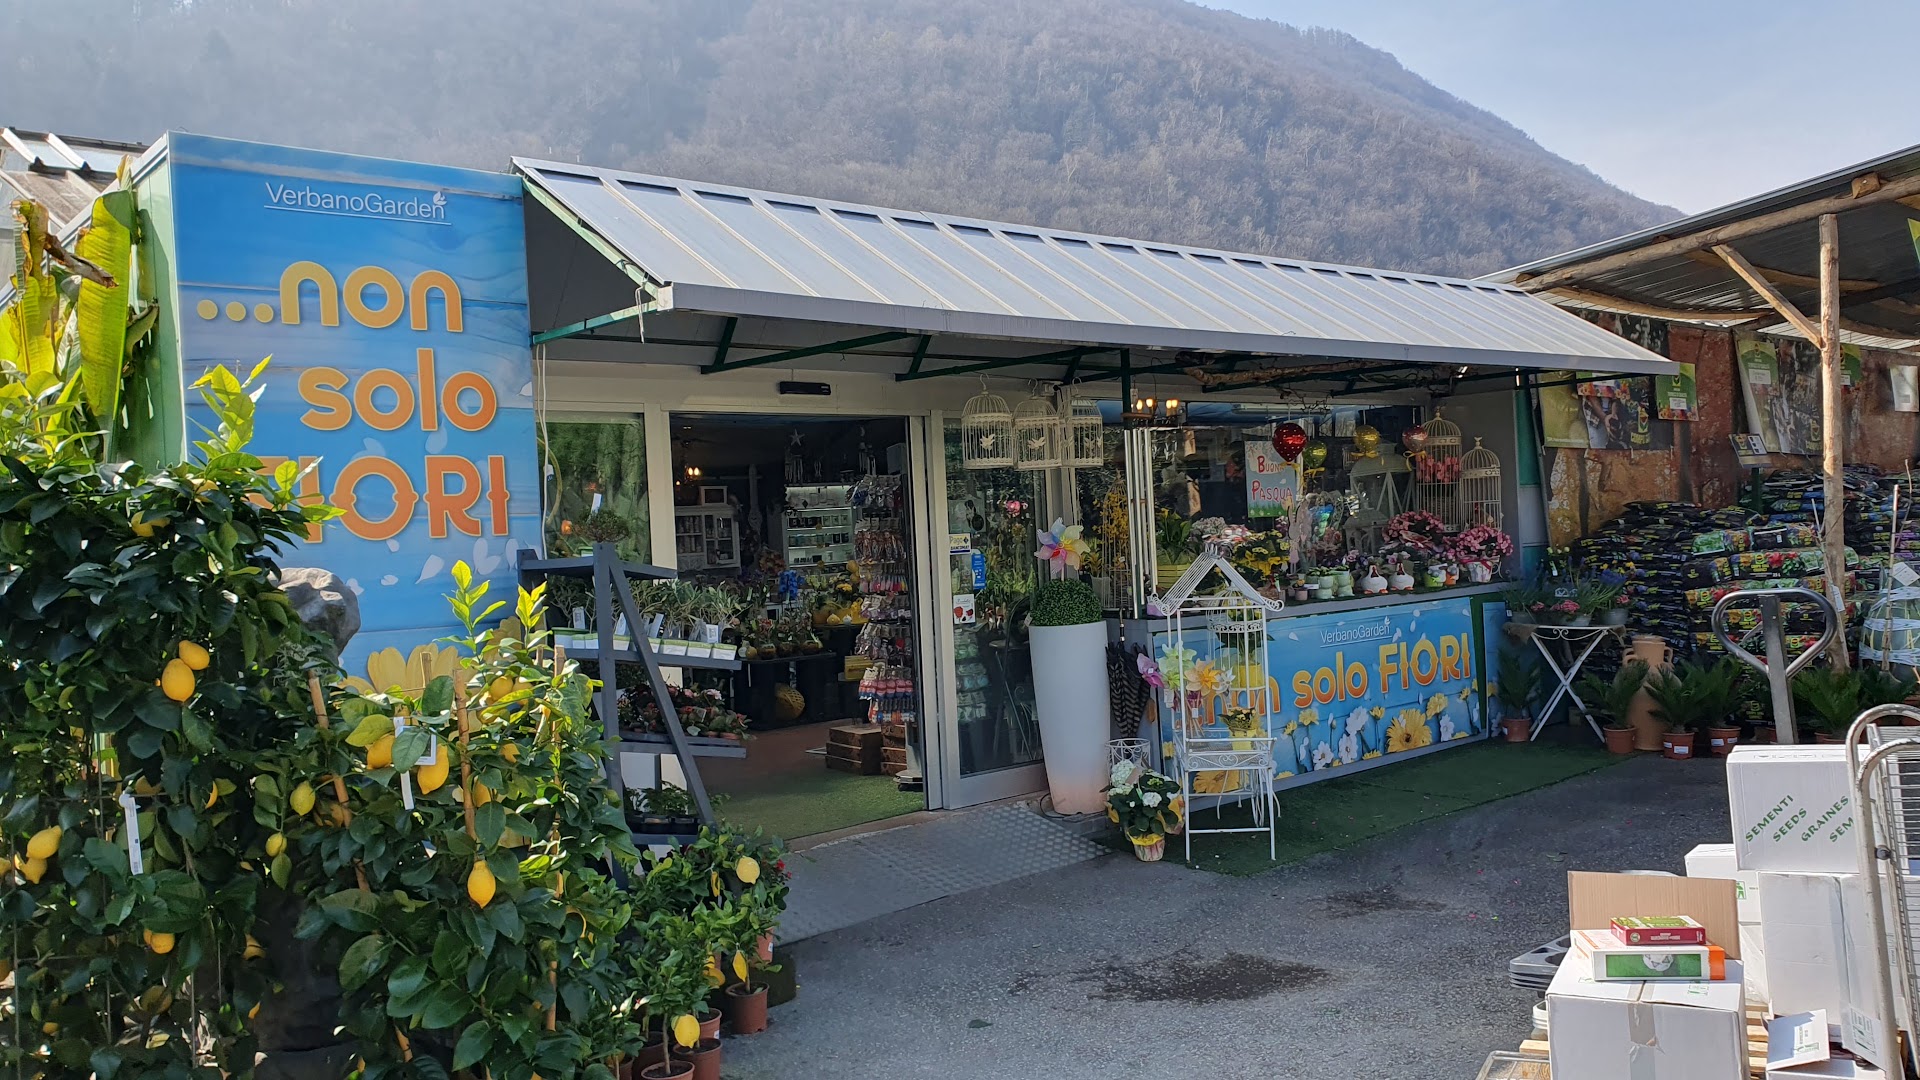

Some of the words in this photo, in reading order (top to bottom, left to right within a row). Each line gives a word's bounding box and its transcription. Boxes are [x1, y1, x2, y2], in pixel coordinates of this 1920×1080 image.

[266, 183, 445, 219] VerbanoGarden
[298, 347, 497, 431] solo
[1321, 624, 1391, 643] VerbanoGarden
[1293, 651, 1368, 708] solo
[1378, 632, 1470, 693] FIORI
[1745, 794, 1794, 842] SEMENTI
[1772, 807, 1807, 842] SEEDS
[1801, 795, 1849, 842] GRAINES
